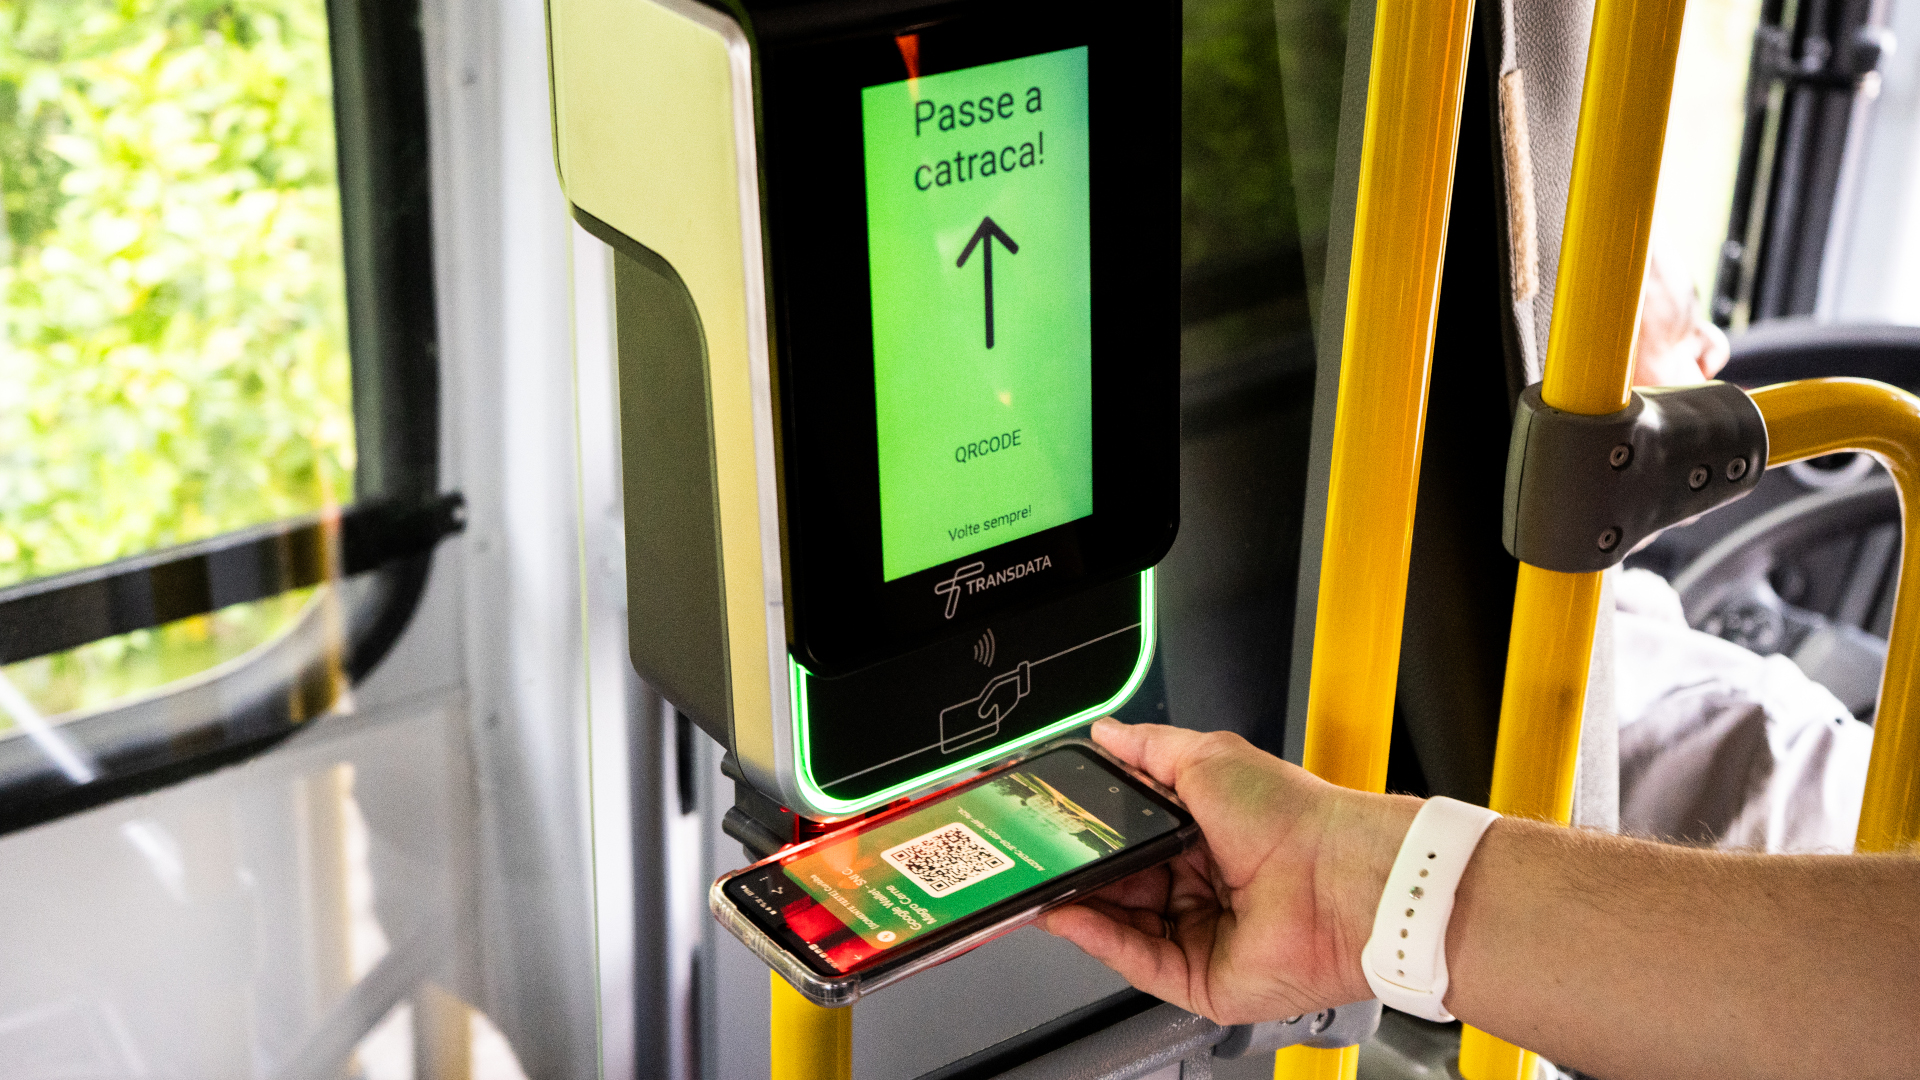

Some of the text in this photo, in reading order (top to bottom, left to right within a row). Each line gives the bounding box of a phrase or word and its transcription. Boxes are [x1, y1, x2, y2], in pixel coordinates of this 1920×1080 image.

[915, 86, 1042, 137] Passe a
[914, 131, 1045, 191] catraca!
[955, 429, 1021, 463] QRCODE
[948, 505, 1032, 541] Volte sempre!
[966, 555, 1052, 595] TRANSDATA
[867, 888, 894, 909] Wallet
[886, 885, 937, 925] Magro Cerne
[892, 906, 922, 930] Google
